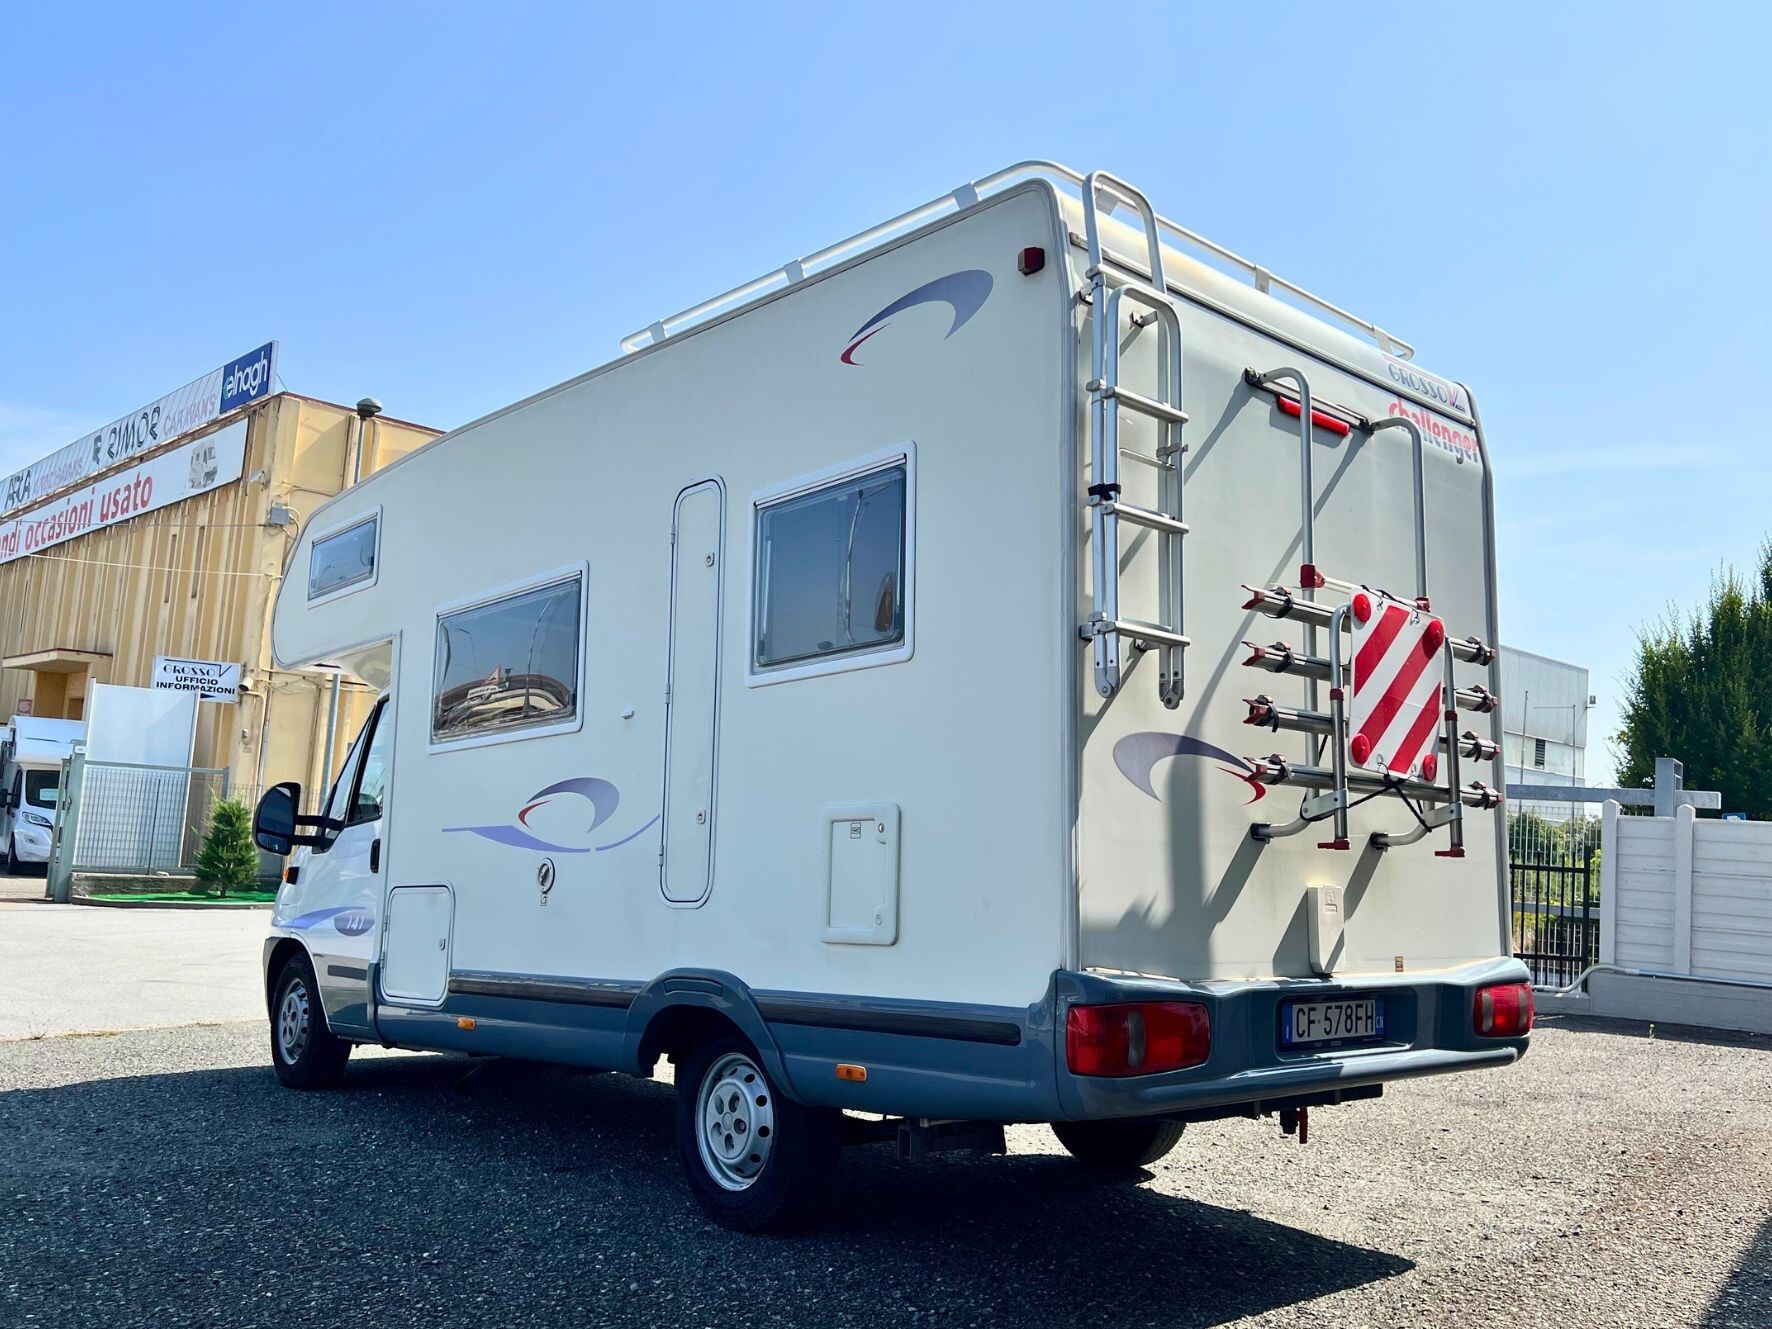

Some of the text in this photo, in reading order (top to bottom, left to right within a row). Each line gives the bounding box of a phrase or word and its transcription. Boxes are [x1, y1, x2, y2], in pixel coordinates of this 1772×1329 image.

[223, 351, 267, 397] elnagh
[1388, 363, 1448, 404] GROSSO
[107, 405, 161, 460] RIMOR
[0, 518, 22, 559] ndi
[25, 486, 95, 551] occasioni
[100, 471, 153, 523] usato
[156, 681, 235, 695] INFORMAZIONI
[163, 663, 216, 677] GROSSO
[175, 675, 218, 686] UFFICIO
